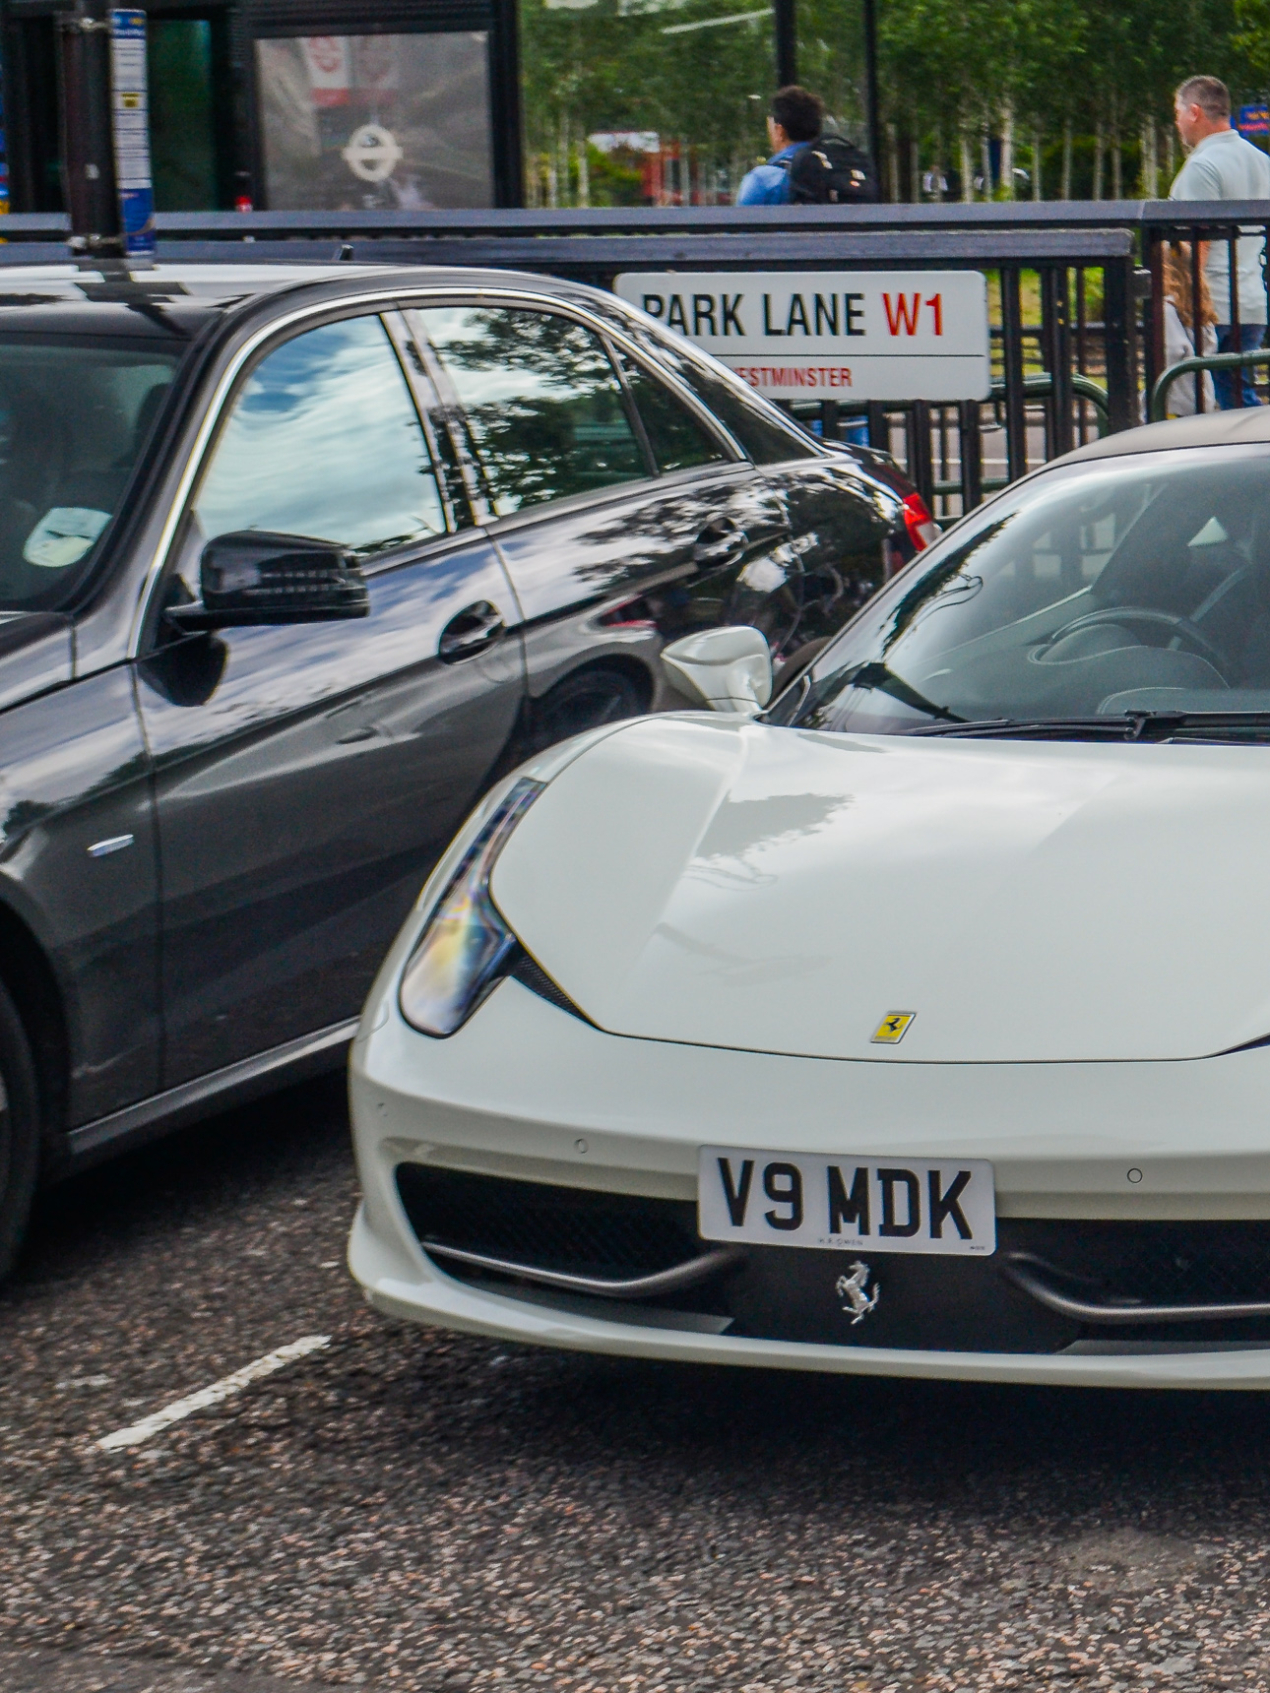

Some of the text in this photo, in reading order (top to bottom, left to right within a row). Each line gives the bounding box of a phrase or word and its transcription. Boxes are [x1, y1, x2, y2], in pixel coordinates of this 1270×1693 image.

[642, 292, 944, 336] PARK LANE W1
[735, 366, 853, 387] ESTMINSTER
[717, 1157, 974, 1240] V9 MDK
